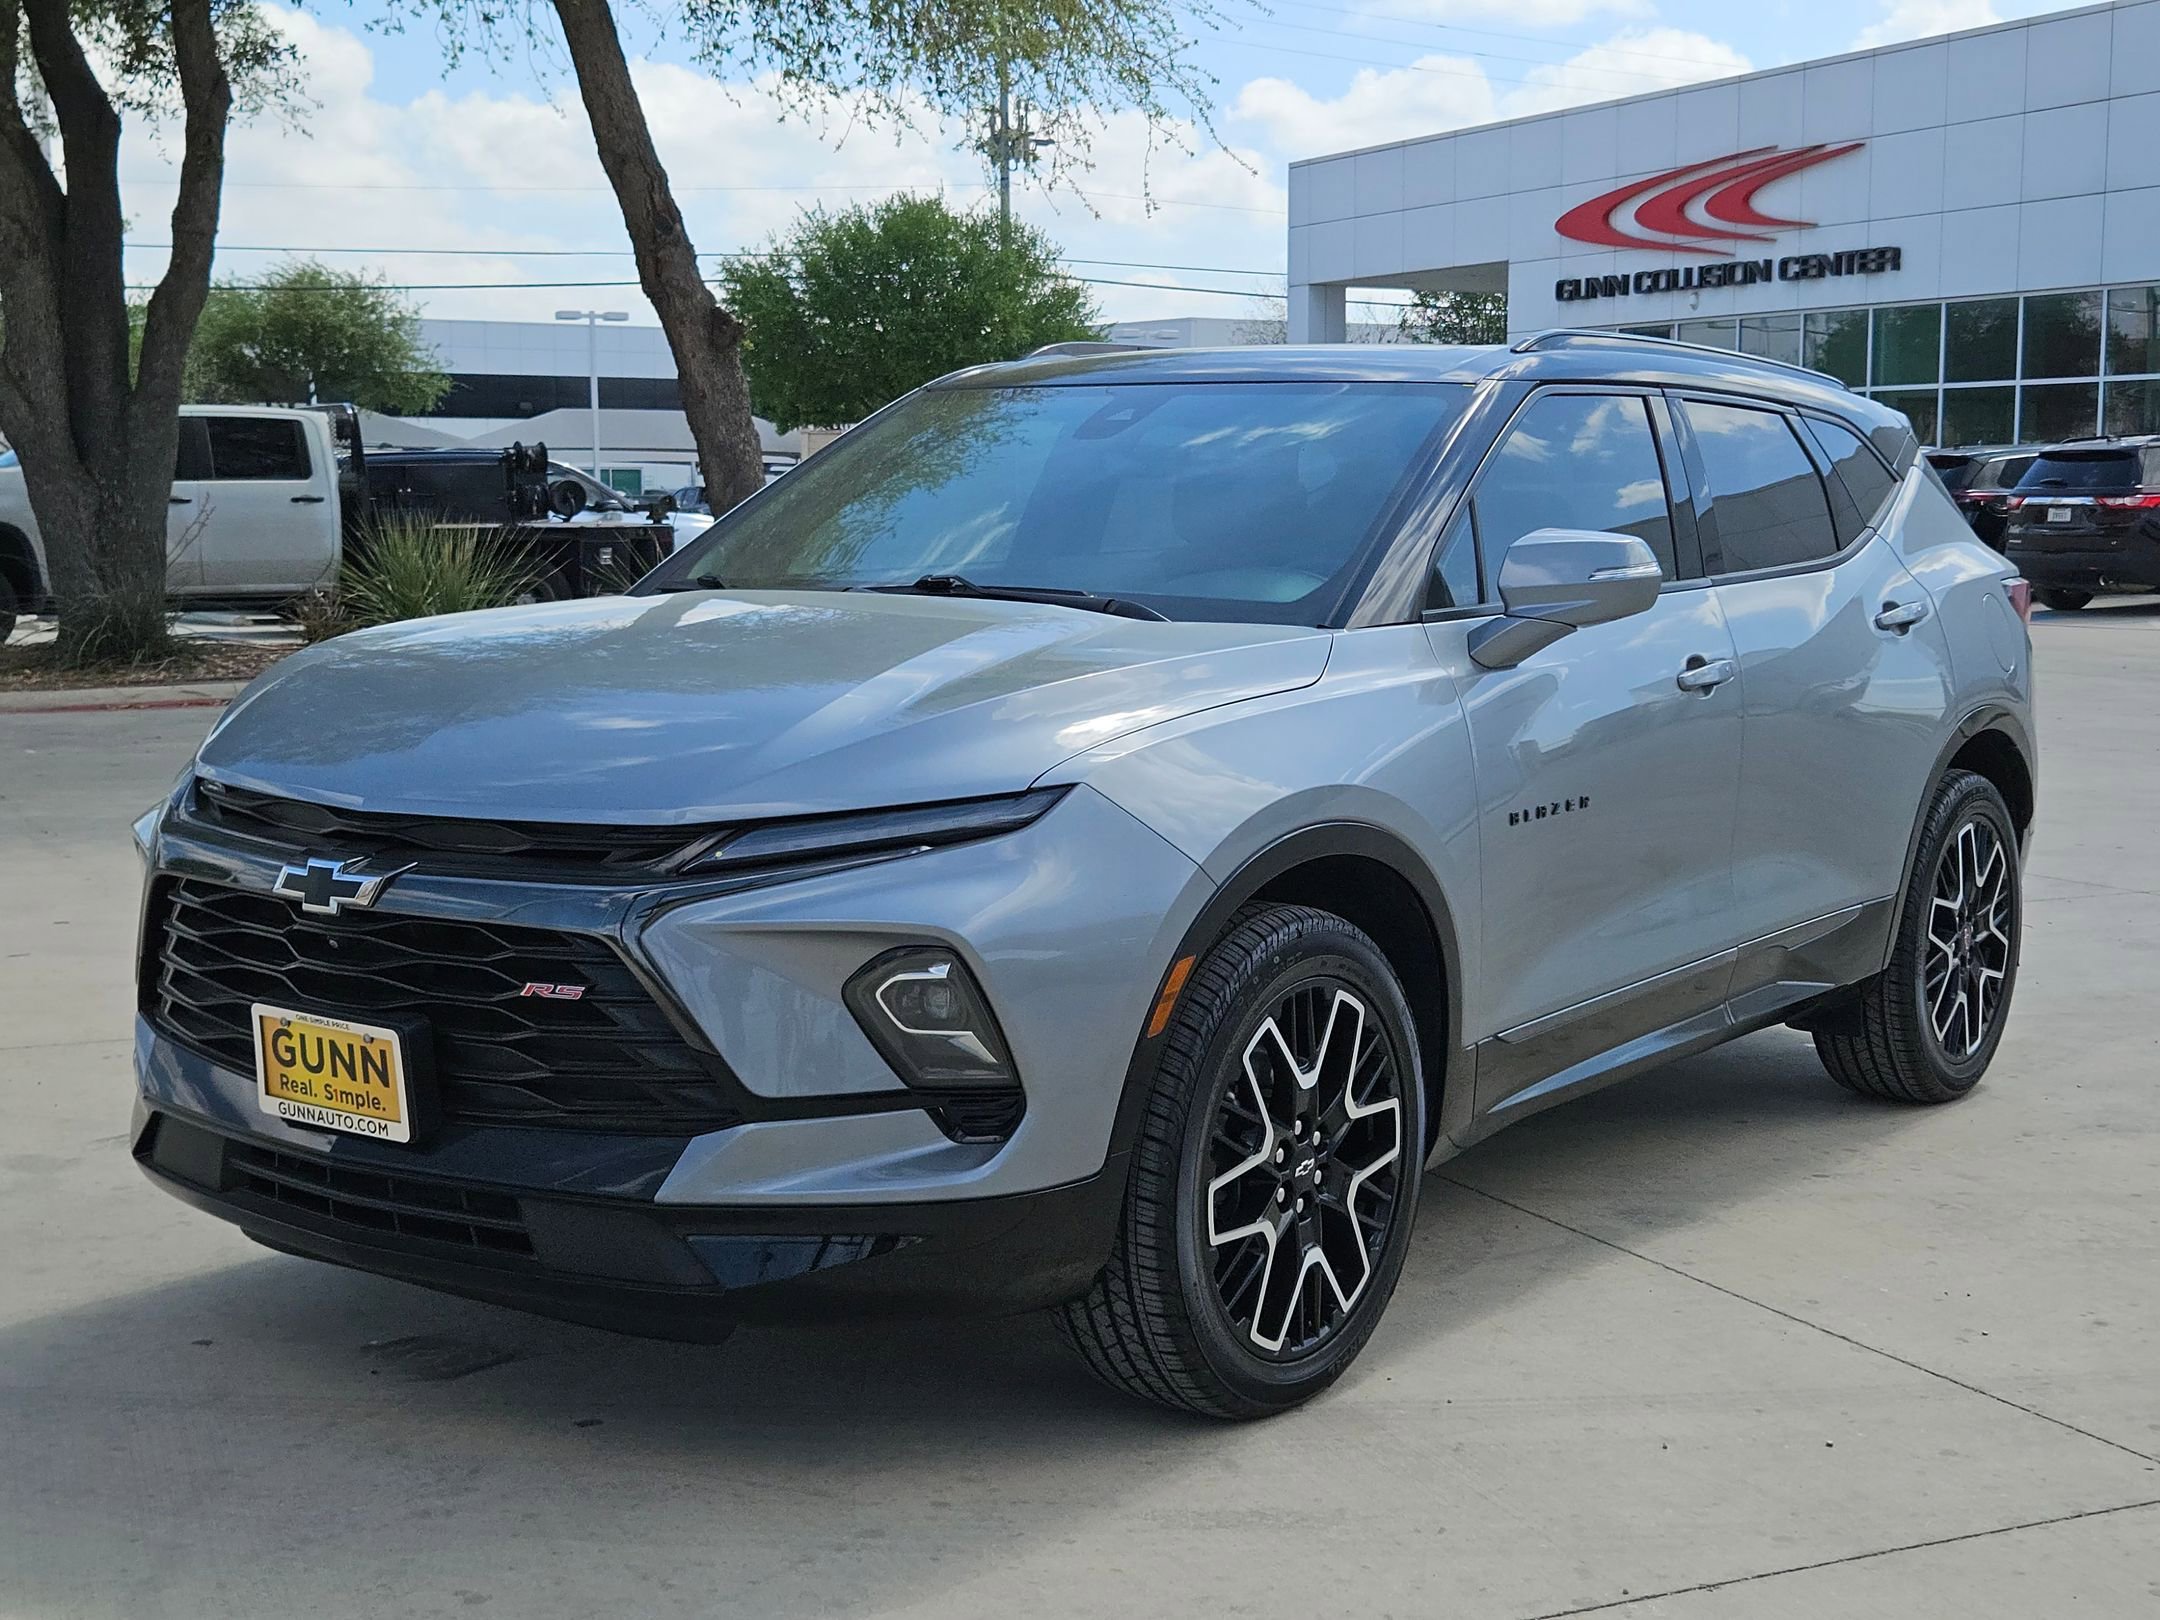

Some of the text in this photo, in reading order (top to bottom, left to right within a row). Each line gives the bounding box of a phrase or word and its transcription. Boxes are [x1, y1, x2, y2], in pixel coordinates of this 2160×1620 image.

[1555, 247, 1902, 301] GUNN COLLISION CENTER
[1509, 796, 1590, 826] BLAZER
[520, 982, 586, 1000] RS
[272, 1028, 390, 1088] GUNN
[280, 1073, 318, 1098] Real.
[278, 1101, 389, 1137] GUNNAUTO.COM
